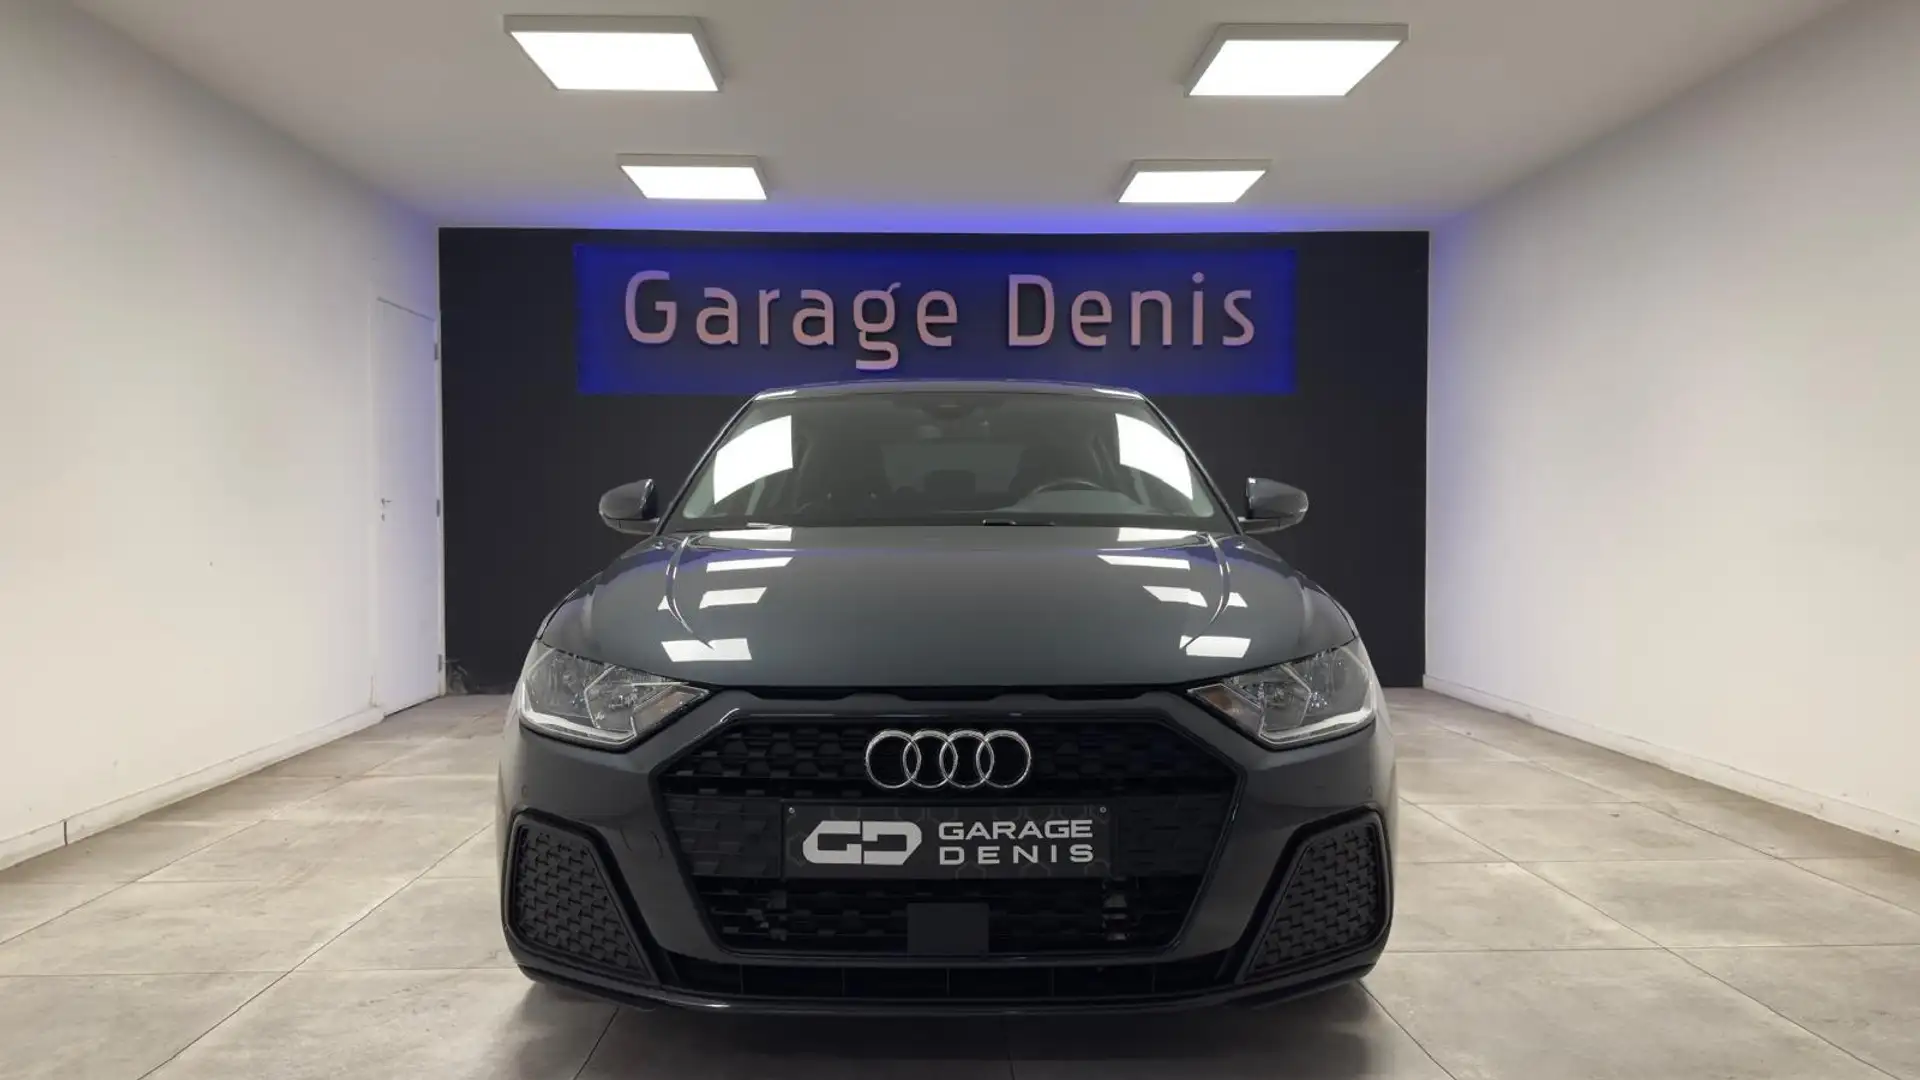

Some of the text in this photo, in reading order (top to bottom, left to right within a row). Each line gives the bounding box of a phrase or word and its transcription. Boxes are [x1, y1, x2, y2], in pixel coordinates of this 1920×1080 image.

[624, 269, 1256, 371] Garage Denis
[938, 819, 1094, 841] GARAGE
[938, 843, 1095, 866] DENIS
